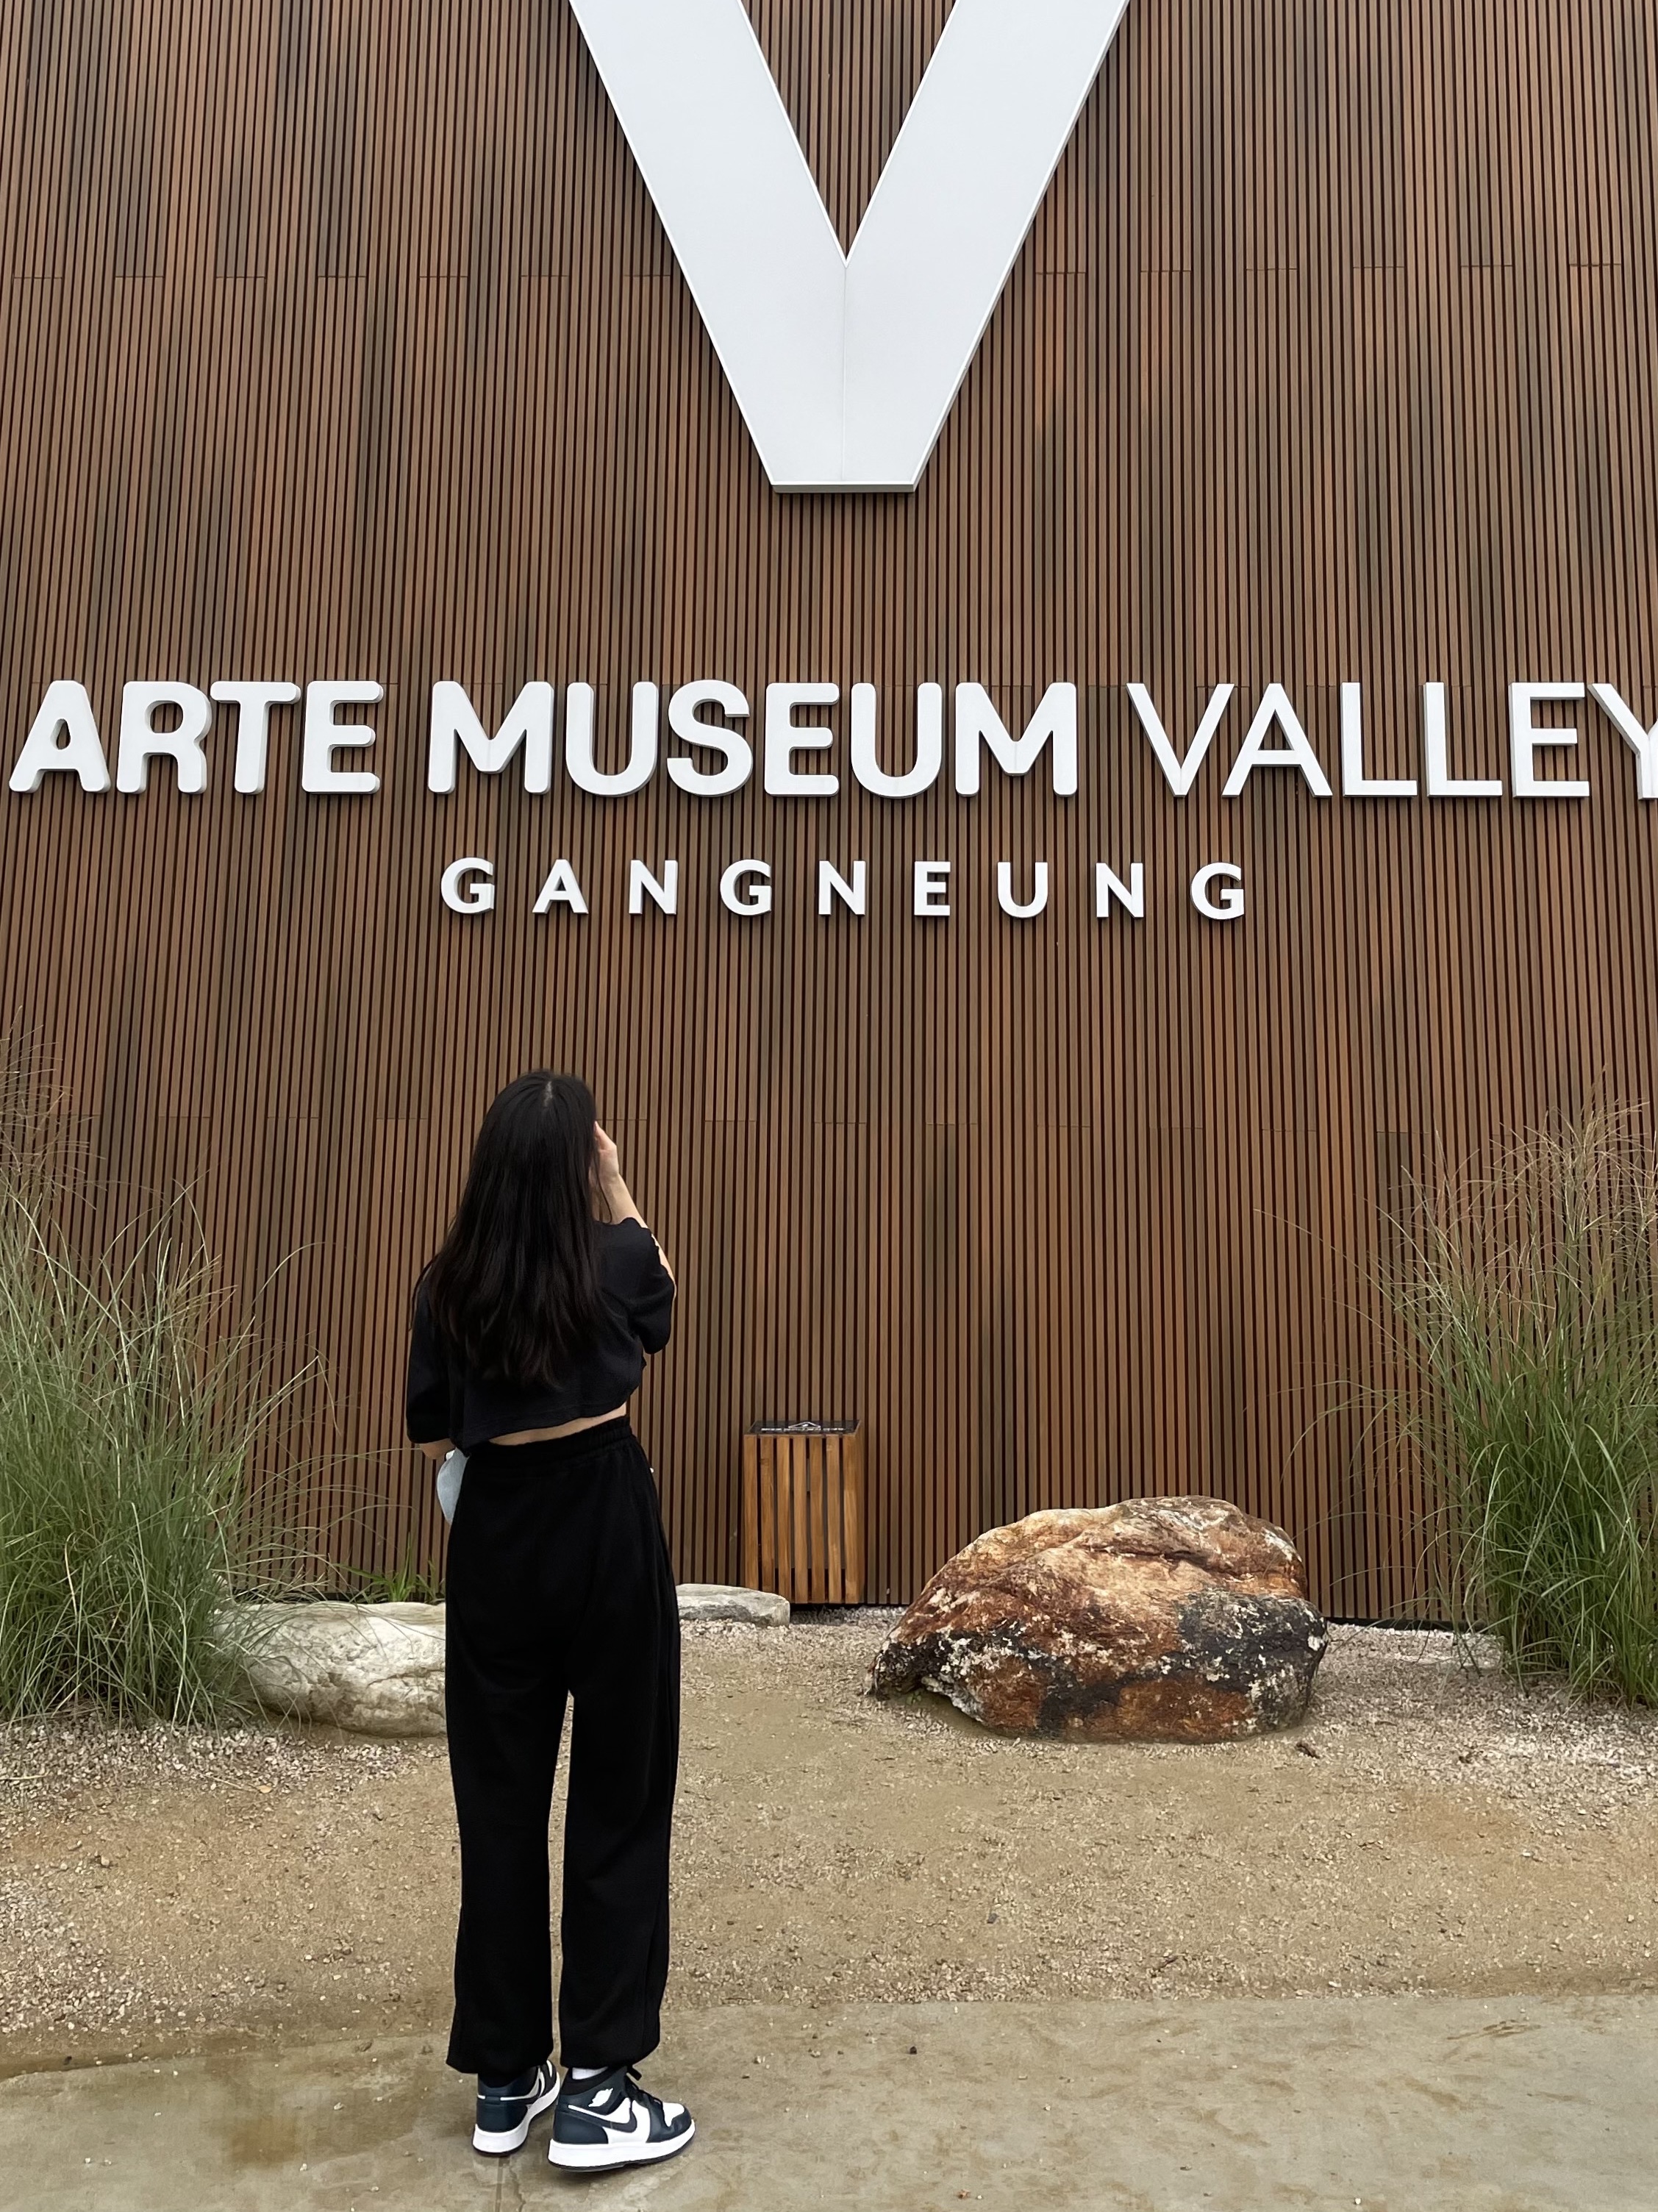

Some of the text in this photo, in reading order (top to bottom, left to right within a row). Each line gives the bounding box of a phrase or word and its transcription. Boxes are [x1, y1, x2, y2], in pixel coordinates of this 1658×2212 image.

[569, 0, 1132, 493] V
[9, 678, 1658, 800] ARTE MUSEUM VALLEY
[440, 857, 1246, 921] GANGNEUNG
